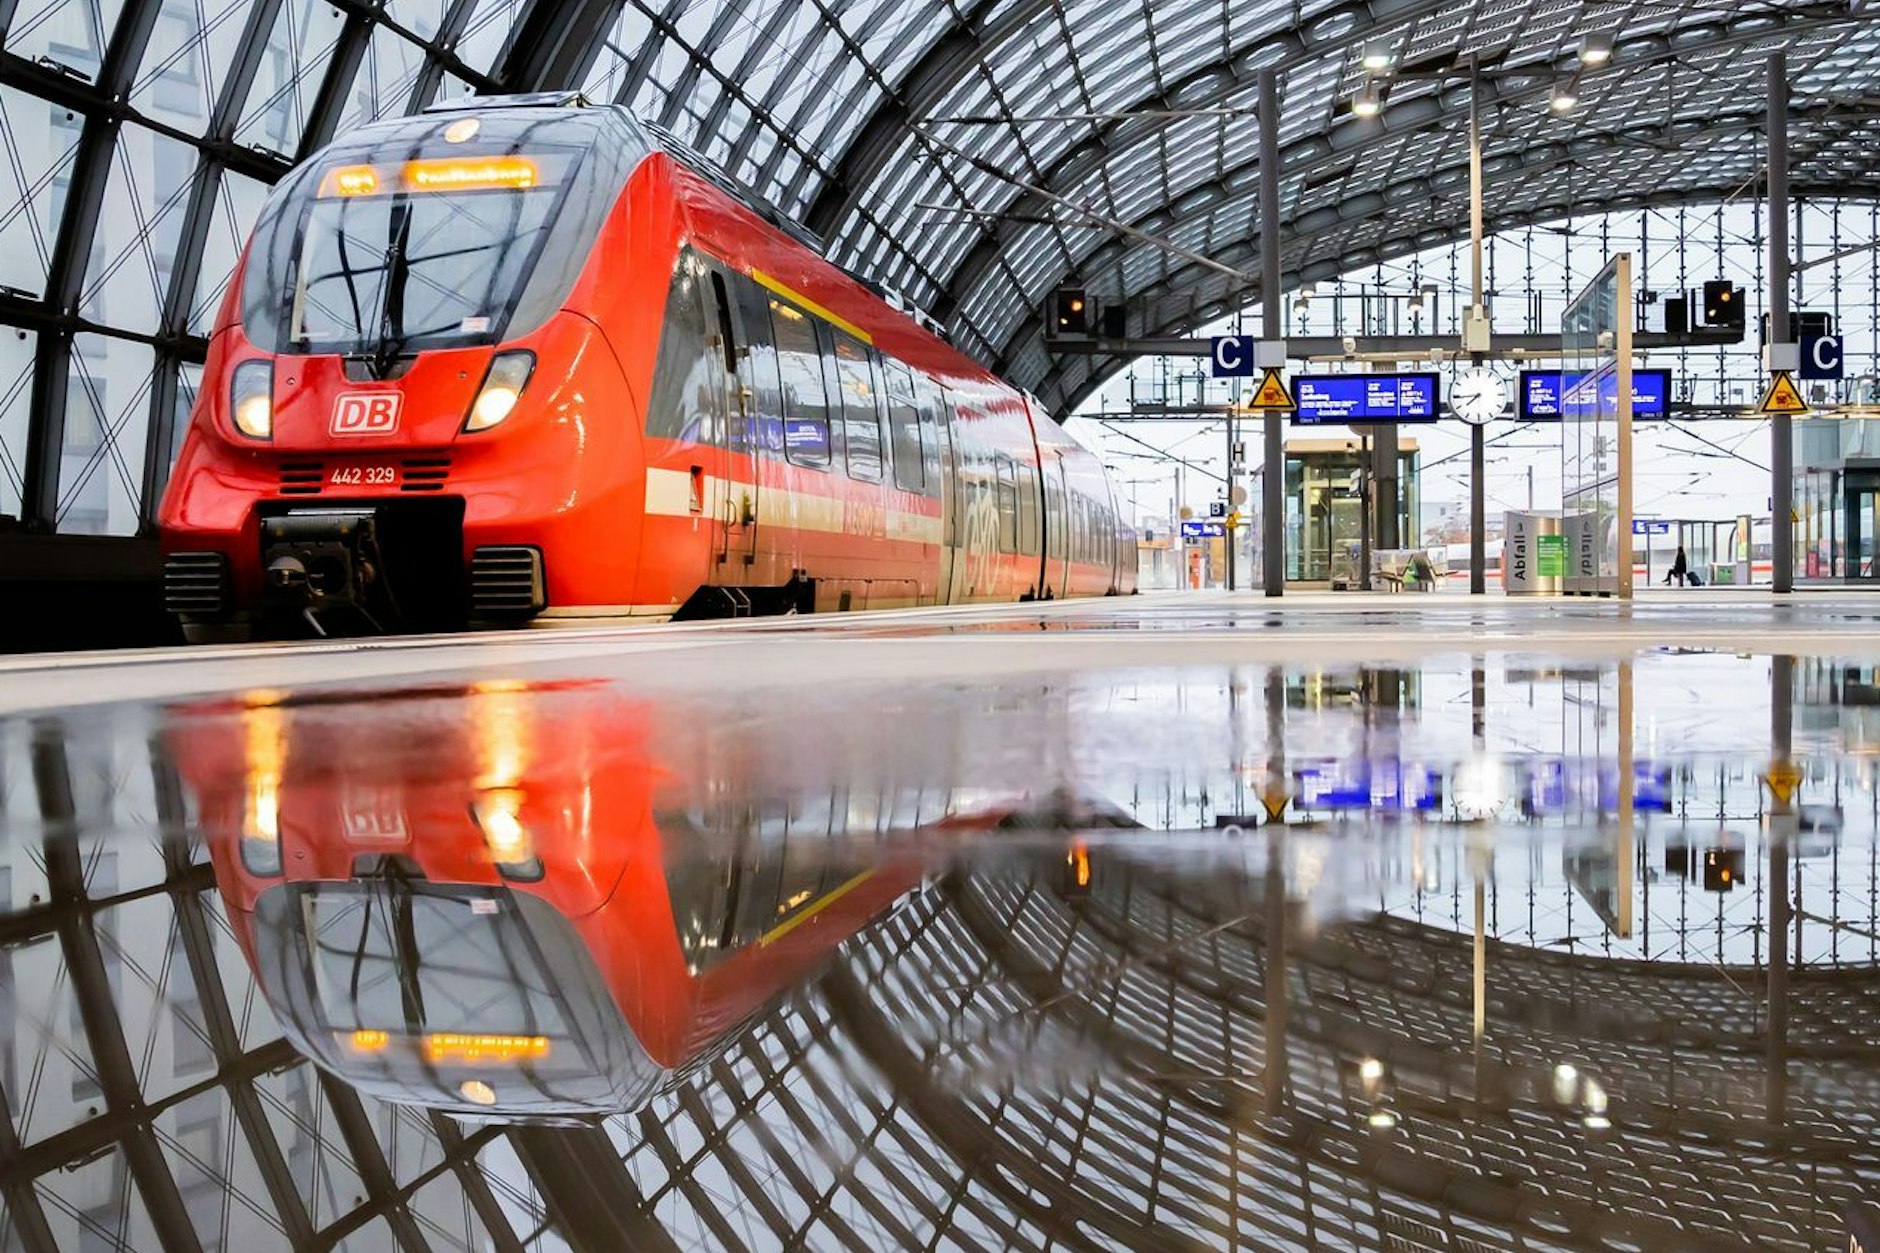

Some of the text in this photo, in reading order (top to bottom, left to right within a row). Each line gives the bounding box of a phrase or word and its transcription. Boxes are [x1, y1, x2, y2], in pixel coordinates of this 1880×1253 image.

[1216, 336, 1242, 370] C
[1812, 335, 1839, 371] C
[340, 398, 393, 429] DB
[1232, 443, 1245, 462] H
[331, 466, 396, 485] 442 329
[1211, 502, 1221, 515] B
[1513, 534, 1526, 581] Abfall
